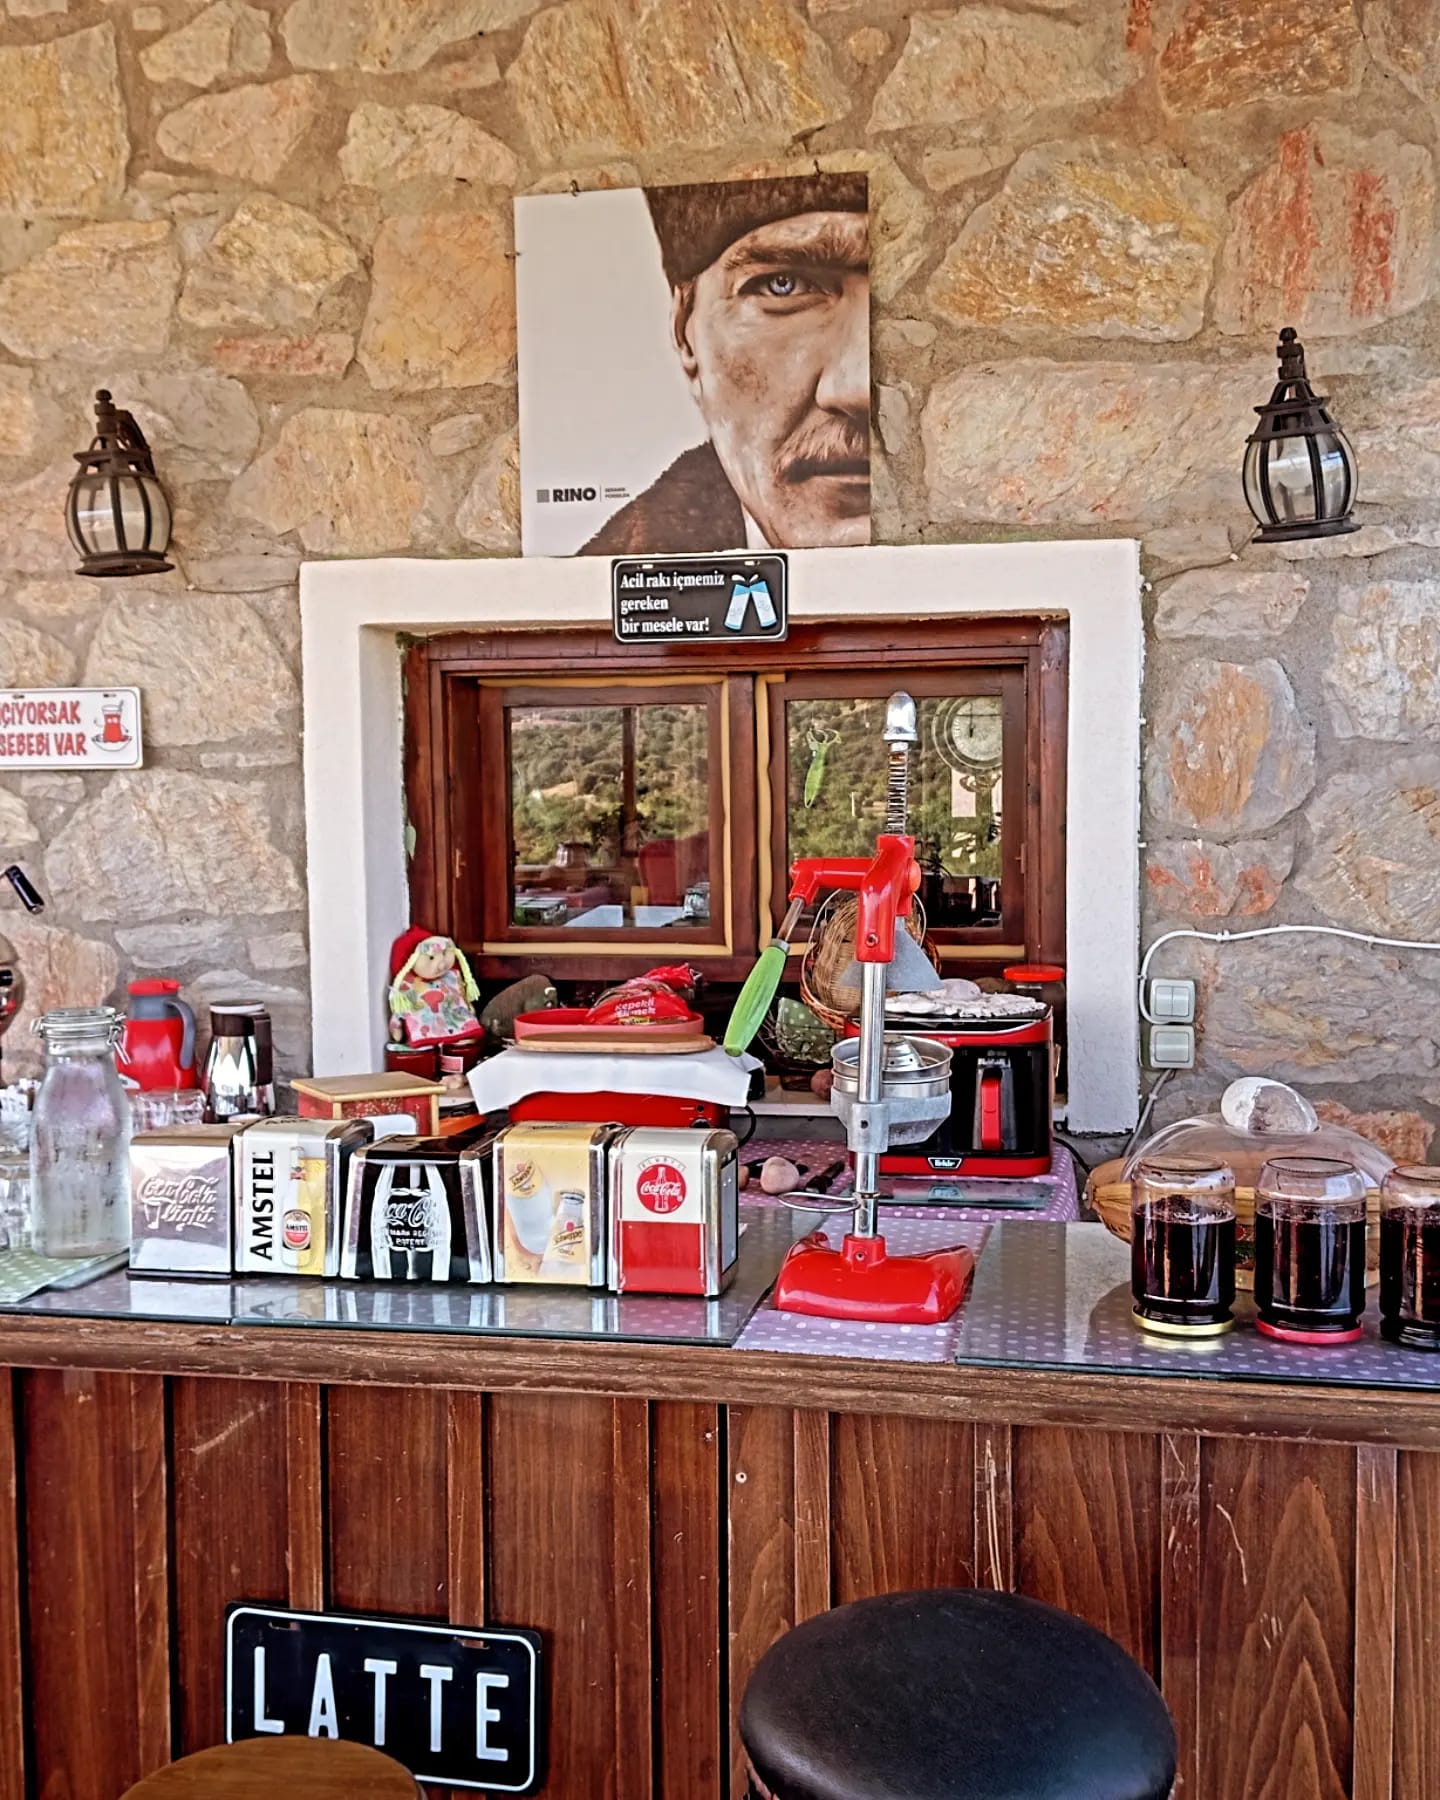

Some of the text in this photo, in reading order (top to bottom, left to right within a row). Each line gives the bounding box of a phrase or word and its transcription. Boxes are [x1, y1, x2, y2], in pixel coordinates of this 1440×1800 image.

[552, 487, 597, 502] RINO
[620, 570, 725, 591] Acil rakı içmemiz
[620, 595, 669, 615] gereken
[622, 617, 710, 633] bir mesele var!
[54, 731, 87, 756] VAR
[137, 1176, 220, 1204] Coca-Cola
[640, 1180, 682, 1200] Coca-Cola
[250, 1151, 274, 1261] AMSTEL
[253, 1645, 510, 1762] LATTE
